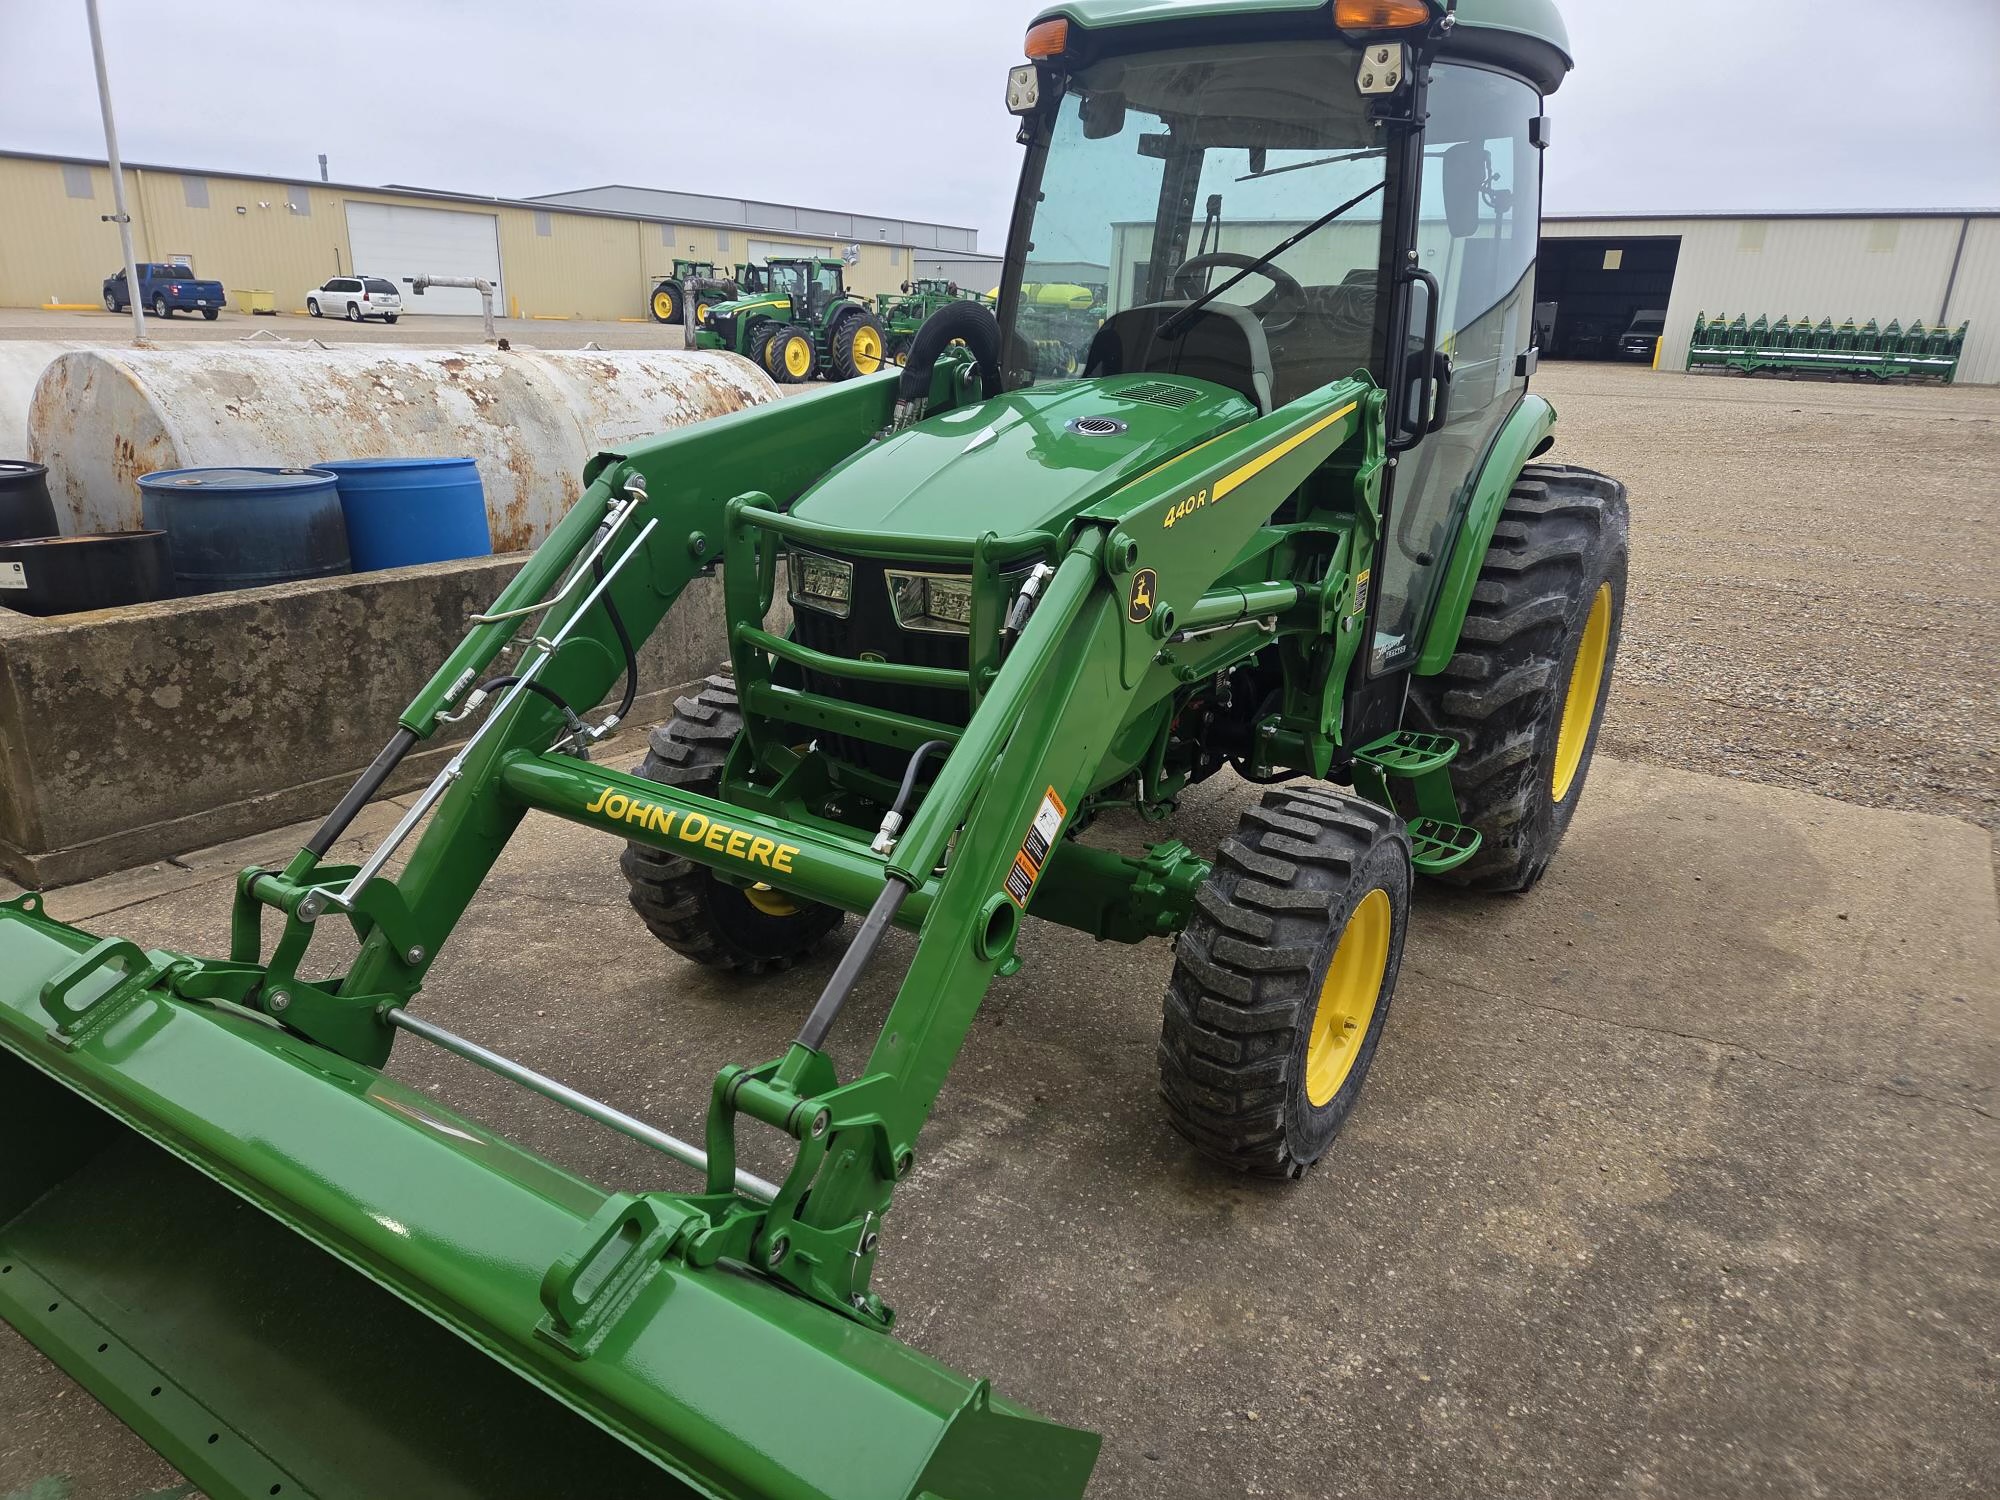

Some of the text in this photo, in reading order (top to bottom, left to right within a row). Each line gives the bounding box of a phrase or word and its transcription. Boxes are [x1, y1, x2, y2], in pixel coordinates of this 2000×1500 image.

[1163, 489, 1207, 528] 440R
[586, 787, 800, 873] JOHN DEERE
